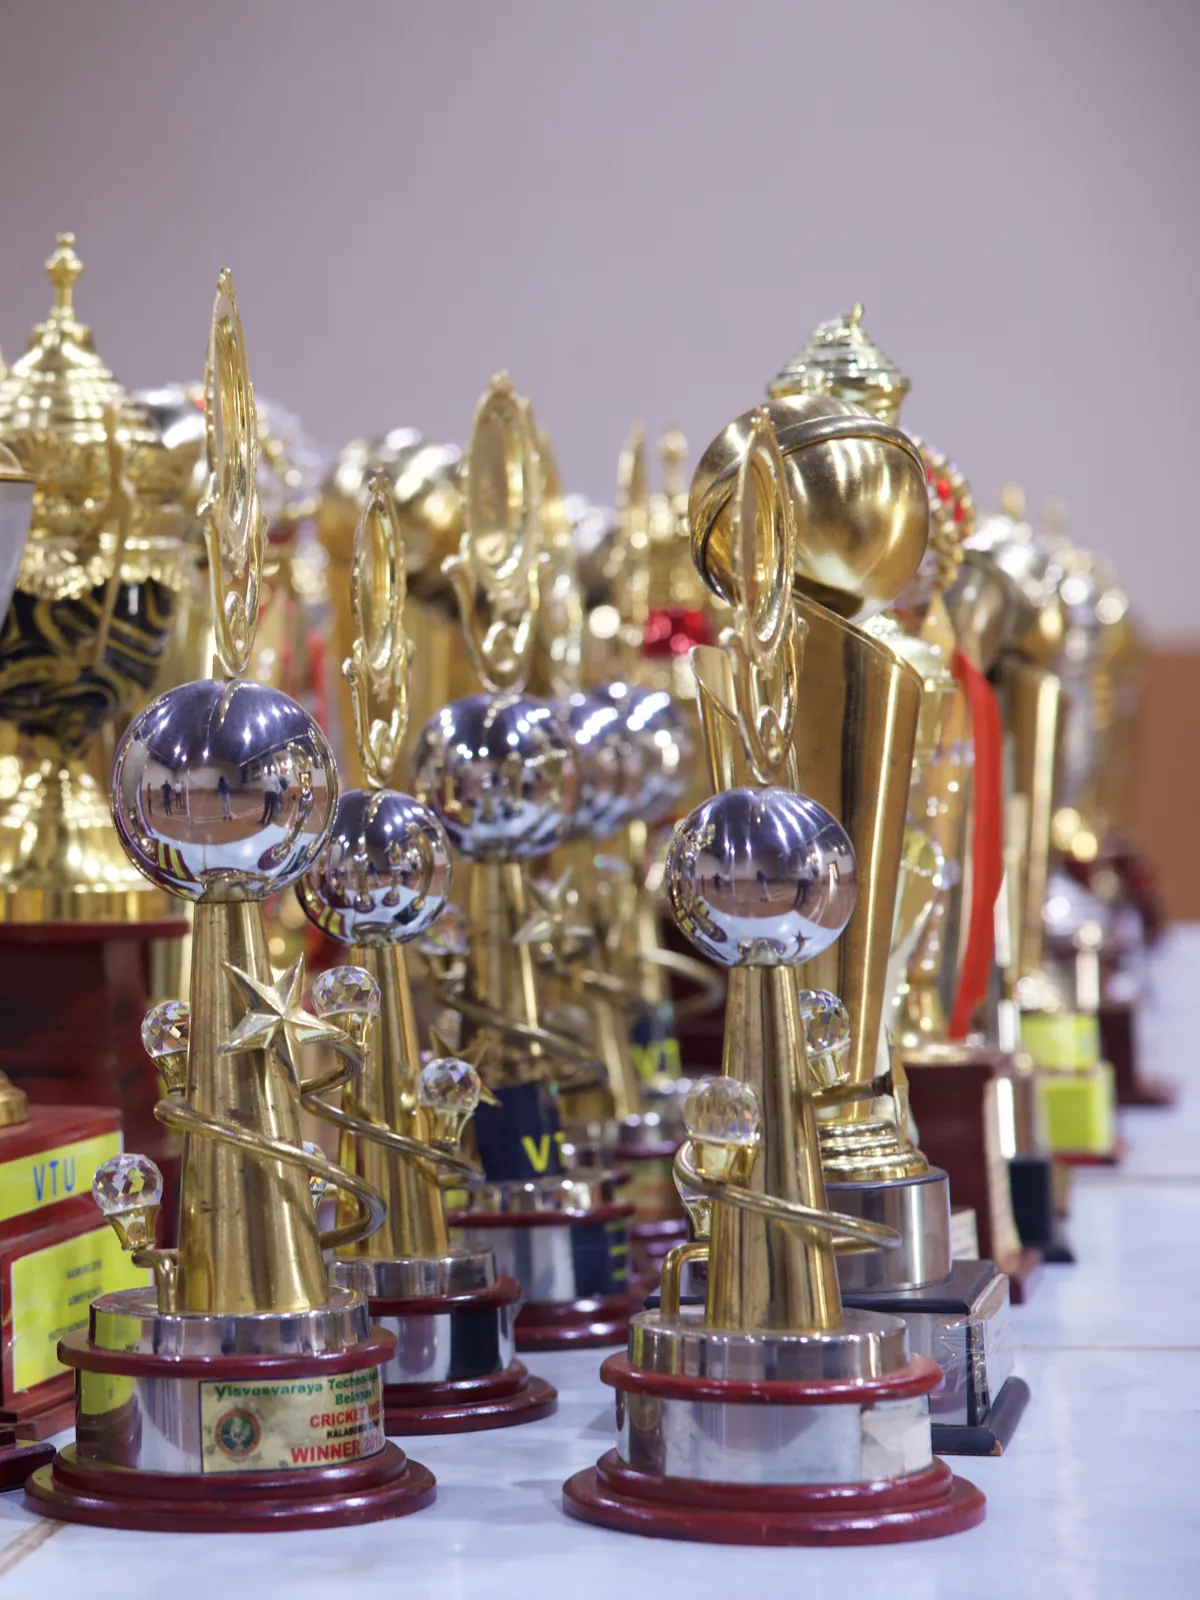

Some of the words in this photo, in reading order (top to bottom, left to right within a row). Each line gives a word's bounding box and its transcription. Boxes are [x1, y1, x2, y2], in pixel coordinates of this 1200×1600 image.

[33, 1156, 76, 1201] VTU
[310, 1406, 365, 1428] CRICKET
[290, 1439, 361, 1464] WINNER
